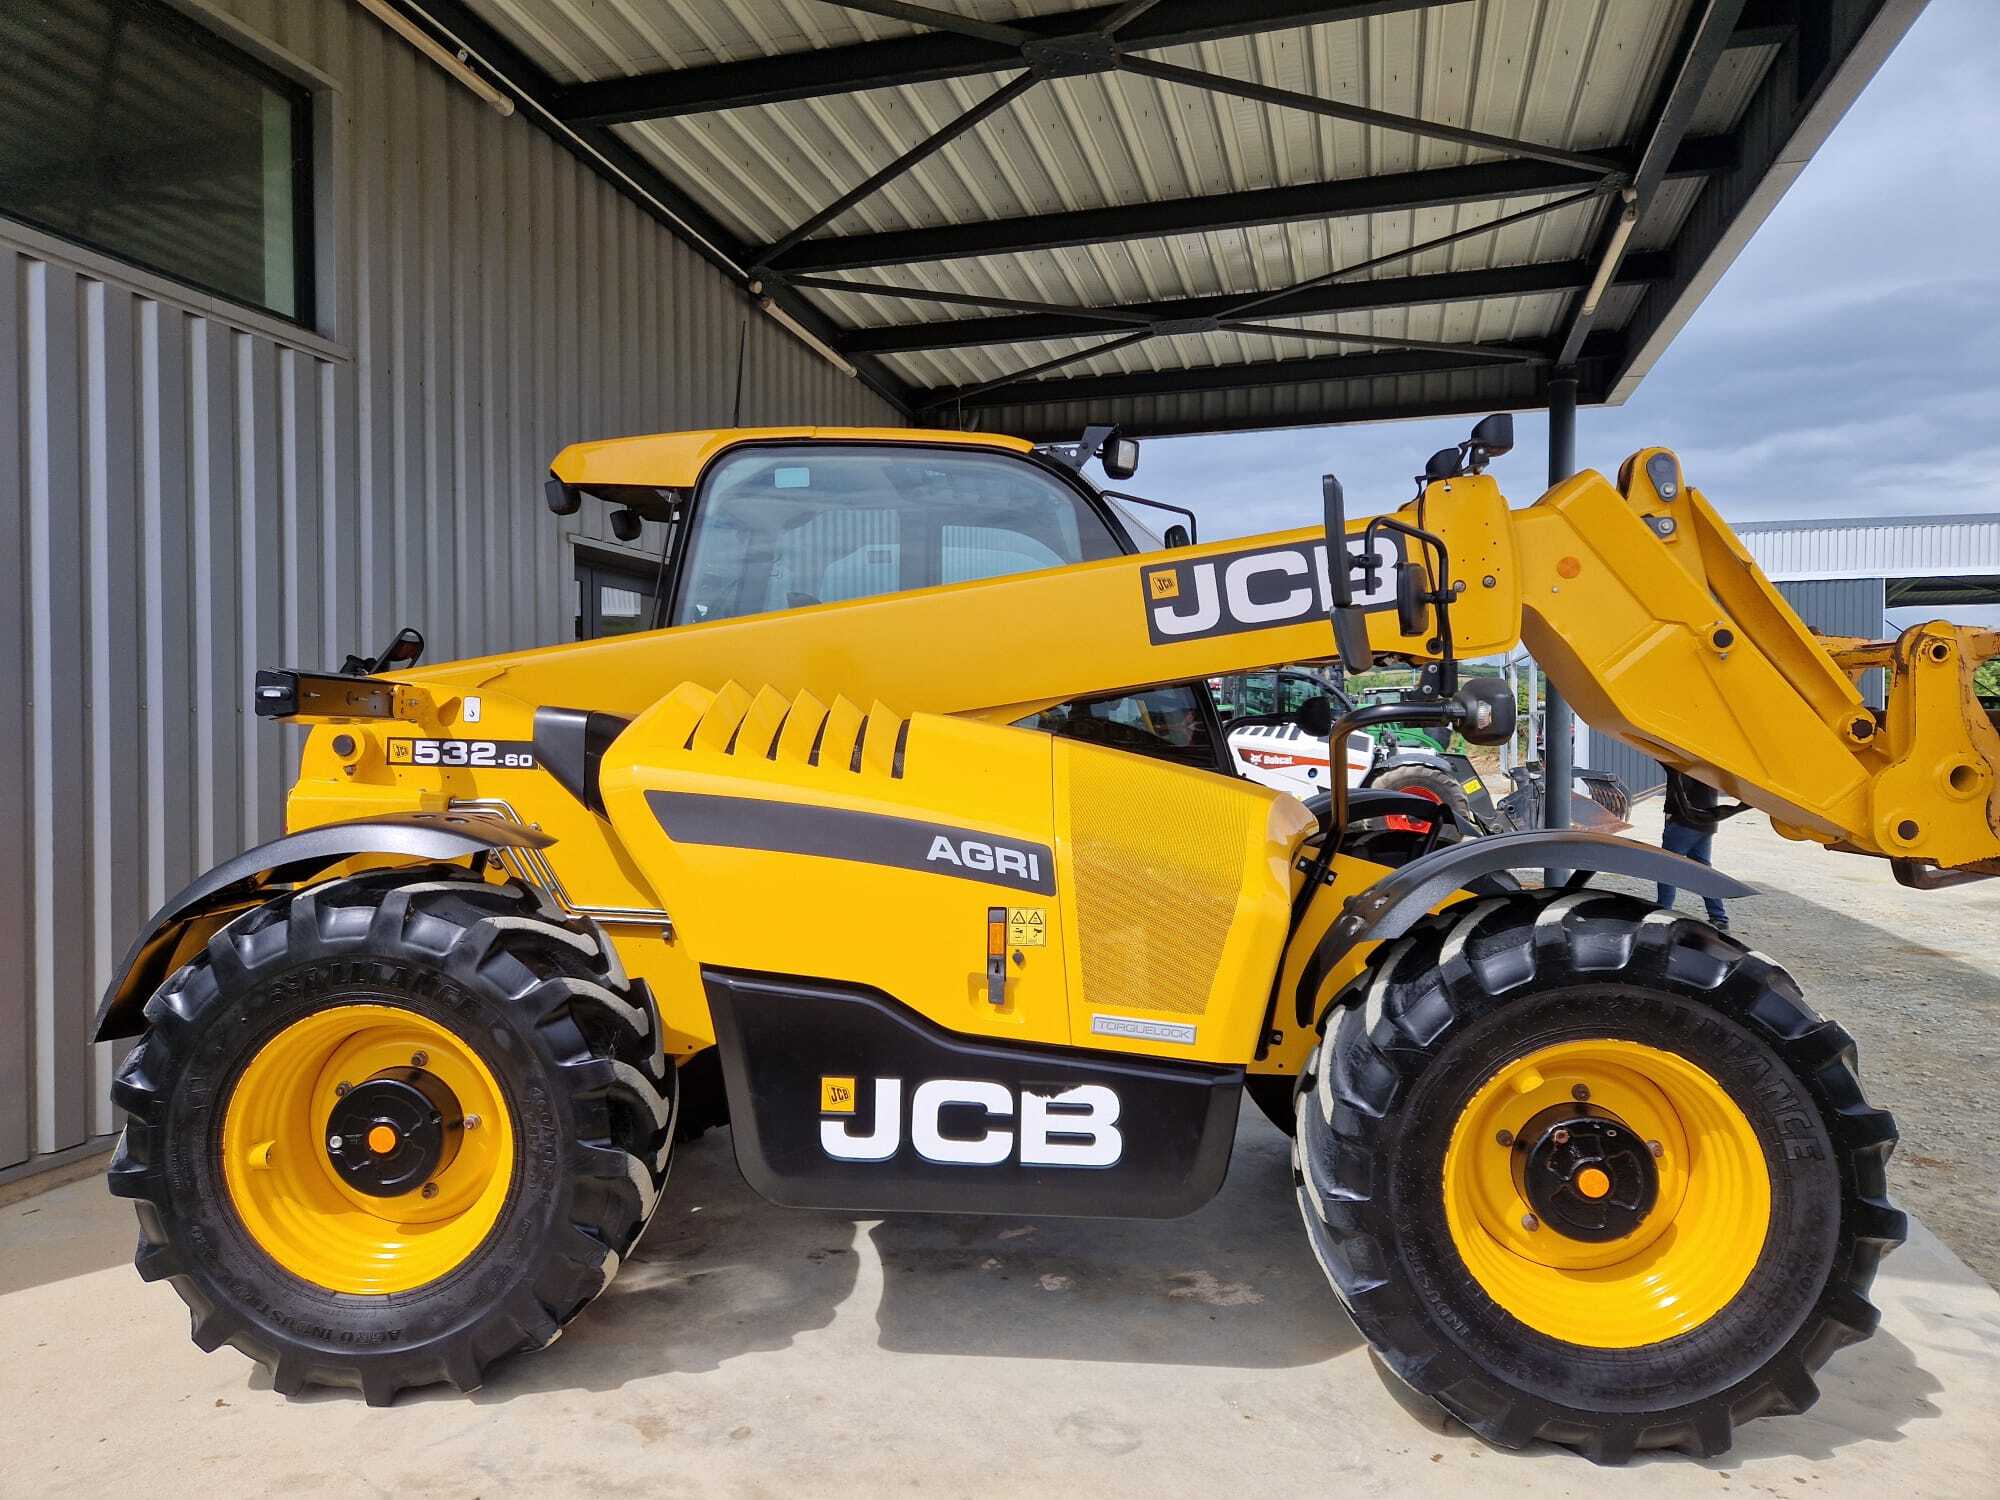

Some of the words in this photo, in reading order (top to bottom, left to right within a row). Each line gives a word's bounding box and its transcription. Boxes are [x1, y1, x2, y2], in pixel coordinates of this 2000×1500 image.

[1152, 536, 1398, 635] JCB
[1263, 755, 1293, 765] Bobcat
[926, 835, 1040, 881] AGRI
[831, 1087, 849, 1103] JCB
[820, 1078, 1123, 1168] JCB
